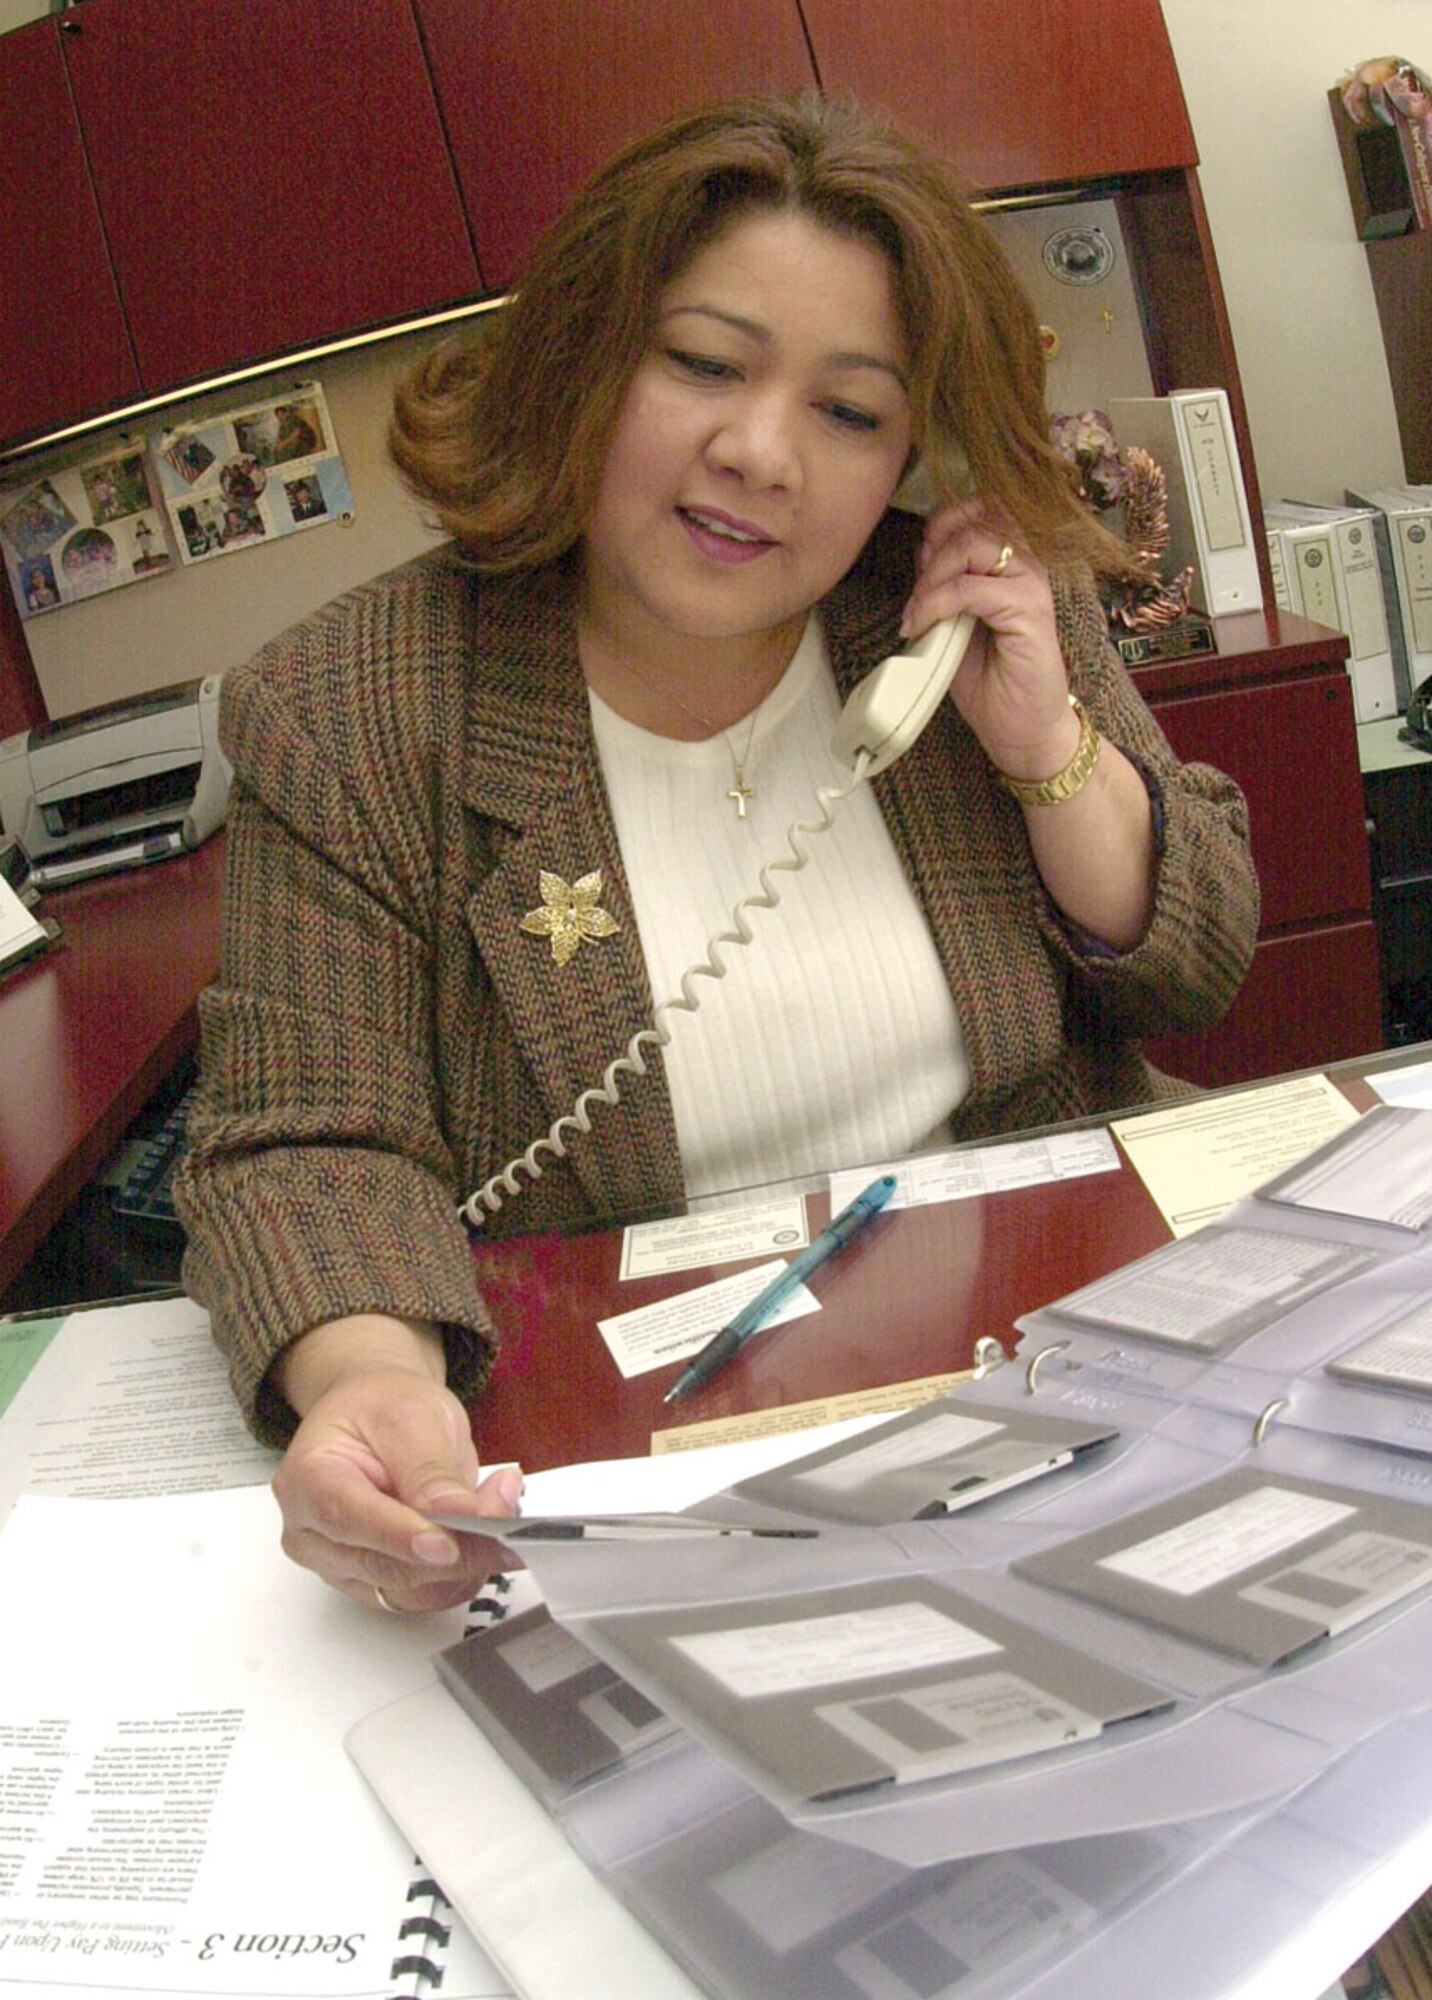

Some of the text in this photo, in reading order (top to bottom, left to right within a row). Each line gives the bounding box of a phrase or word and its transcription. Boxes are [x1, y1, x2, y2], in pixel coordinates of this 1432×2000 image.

[14, 1932, 61, 1953] Upon
[66, 1932, 100, 1955] Pay
[104, 1935, 171, 1959] Setting
[199, 1933, 225, 1961] 3
[234, 1934, 365, 1964] Section
